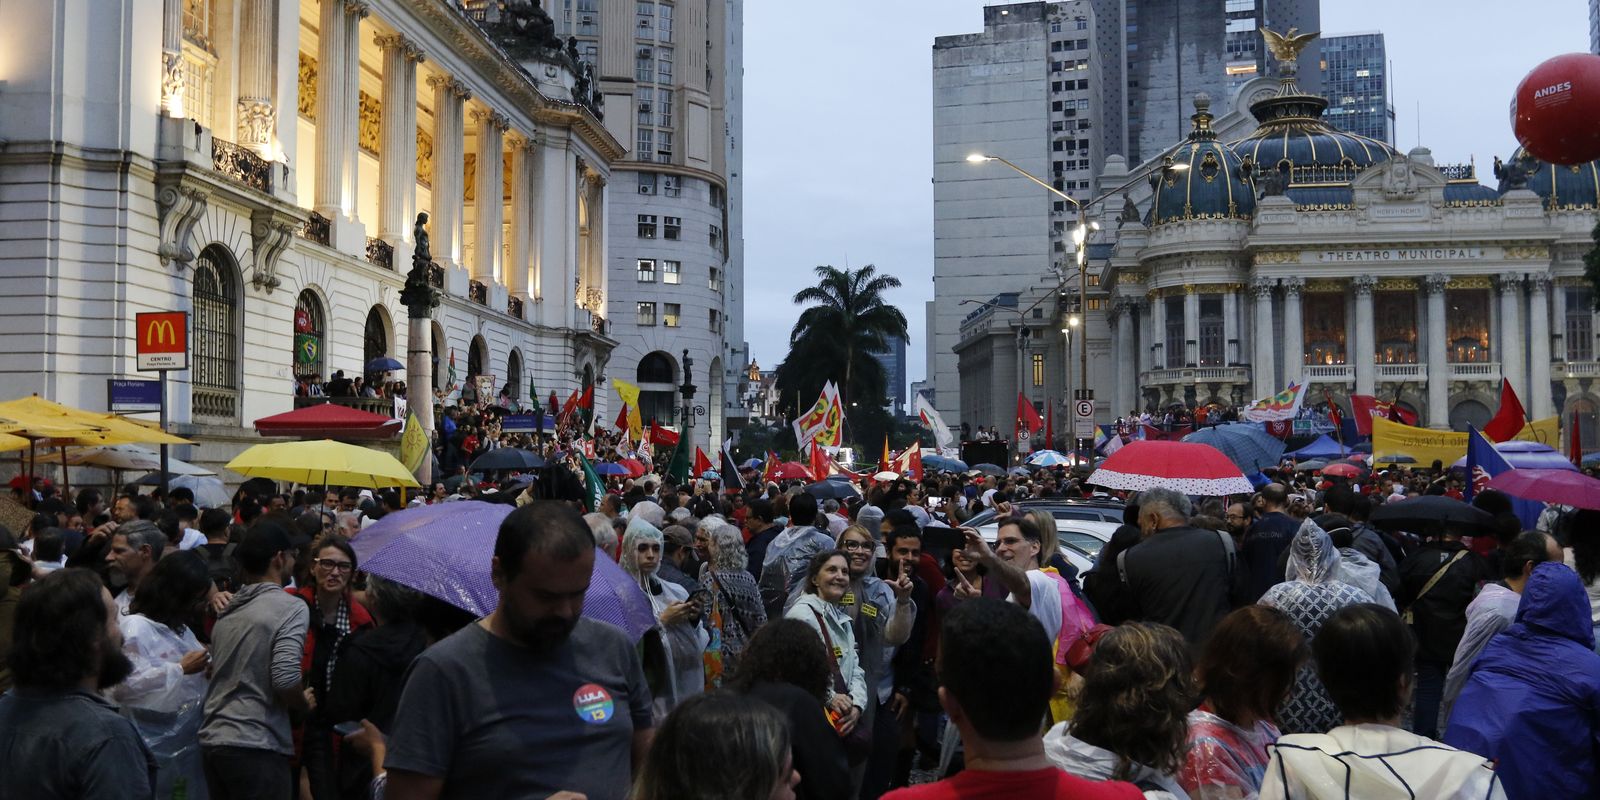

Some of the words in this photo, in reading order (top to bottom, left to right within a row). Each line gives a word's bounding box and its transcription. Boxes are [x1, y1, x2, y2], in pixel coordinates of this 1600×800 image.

[1534, 81, 1572, 99] ANDES
[1327, 251, 1390, 262] THEATRO
[1398, 249, 1475, 260] MUNICIPAL
[1081, 404, 1088, 413] E
[577, 690, 605, 703] LULA
[592, 709, 606, 721] 13
